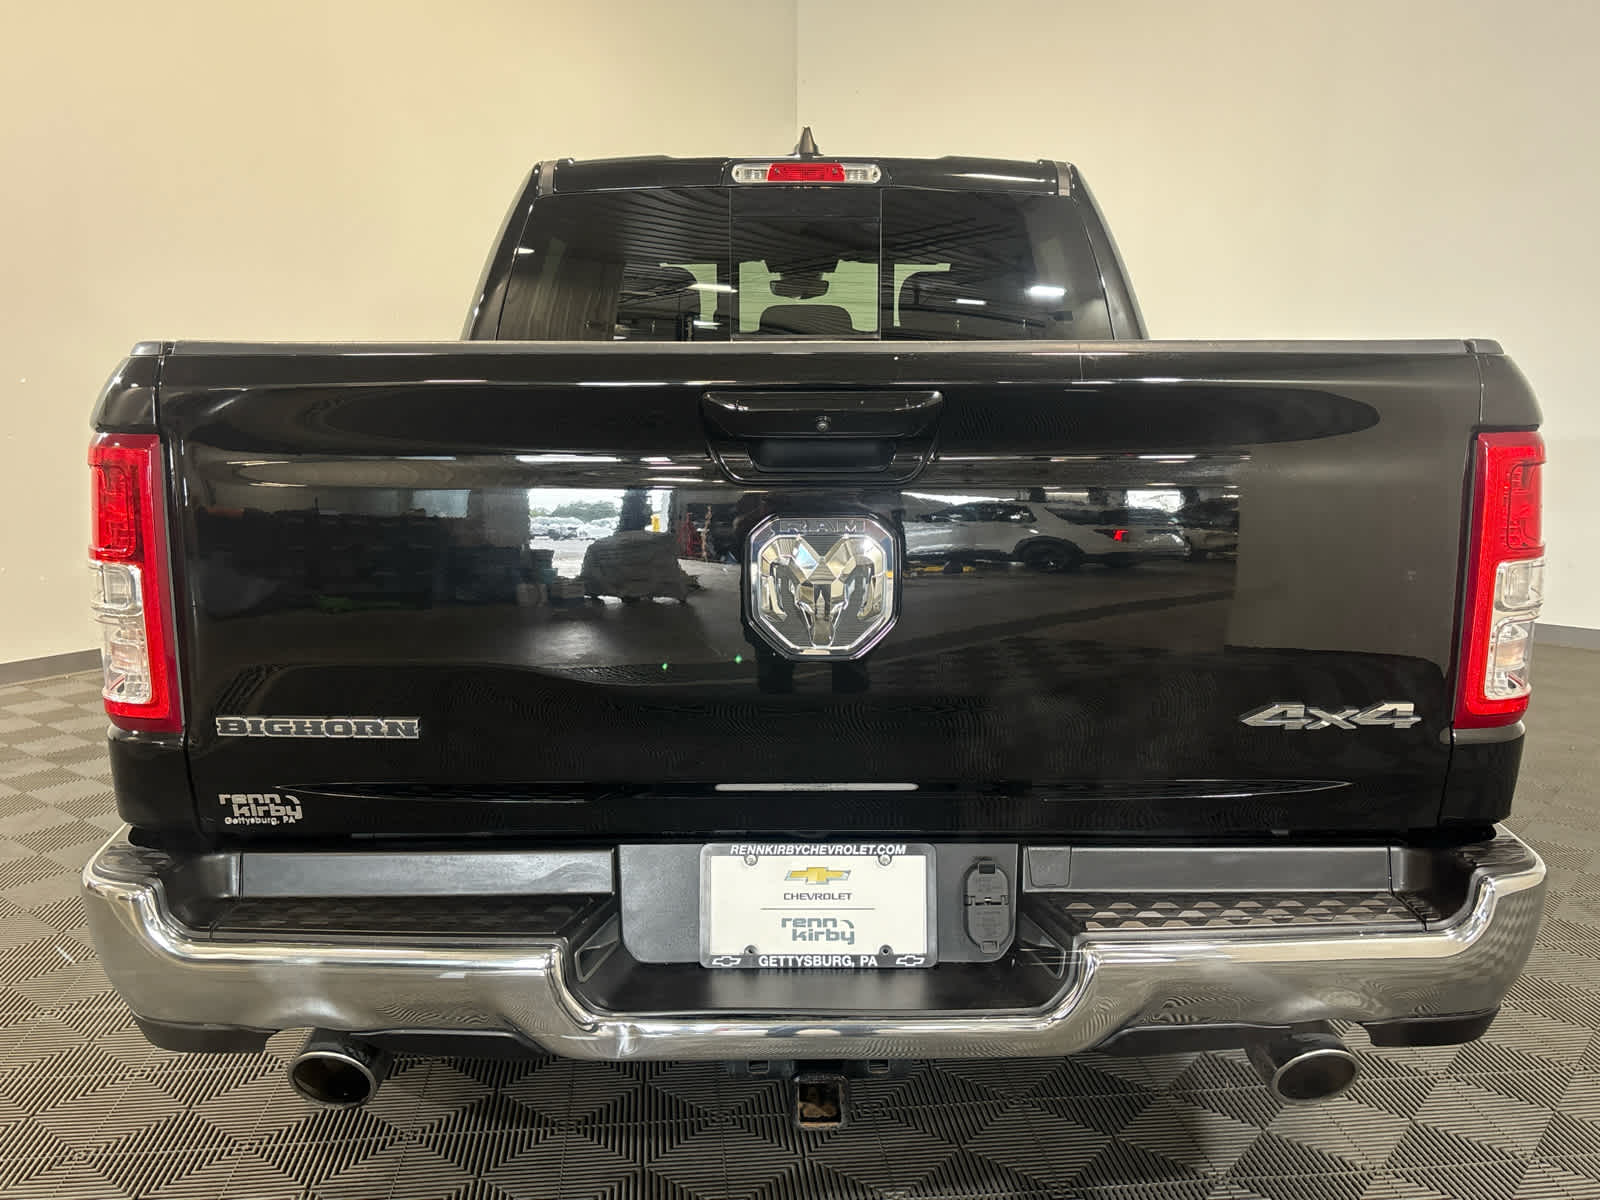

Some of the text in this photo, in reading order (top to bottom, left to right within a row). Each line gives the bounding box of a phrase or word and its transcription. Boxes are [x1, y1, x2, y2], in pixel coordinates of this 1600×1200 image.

[216, 716, 420, 739] BIGHORN
[218, 793, 281, 805] renn
[232, 803, 303, 820] kirby
[283, 816, 296, 825] PA
[730, 844, 906, 856] RENNKIRBYCHEVROLET.COM
[783, 892, 852, 901] CHEVROLET
[781, 917, 838, 929] renn
[792, 928, 855, 945] kirby
[758, 955, 878, 968] GETTYSBURG, PA
